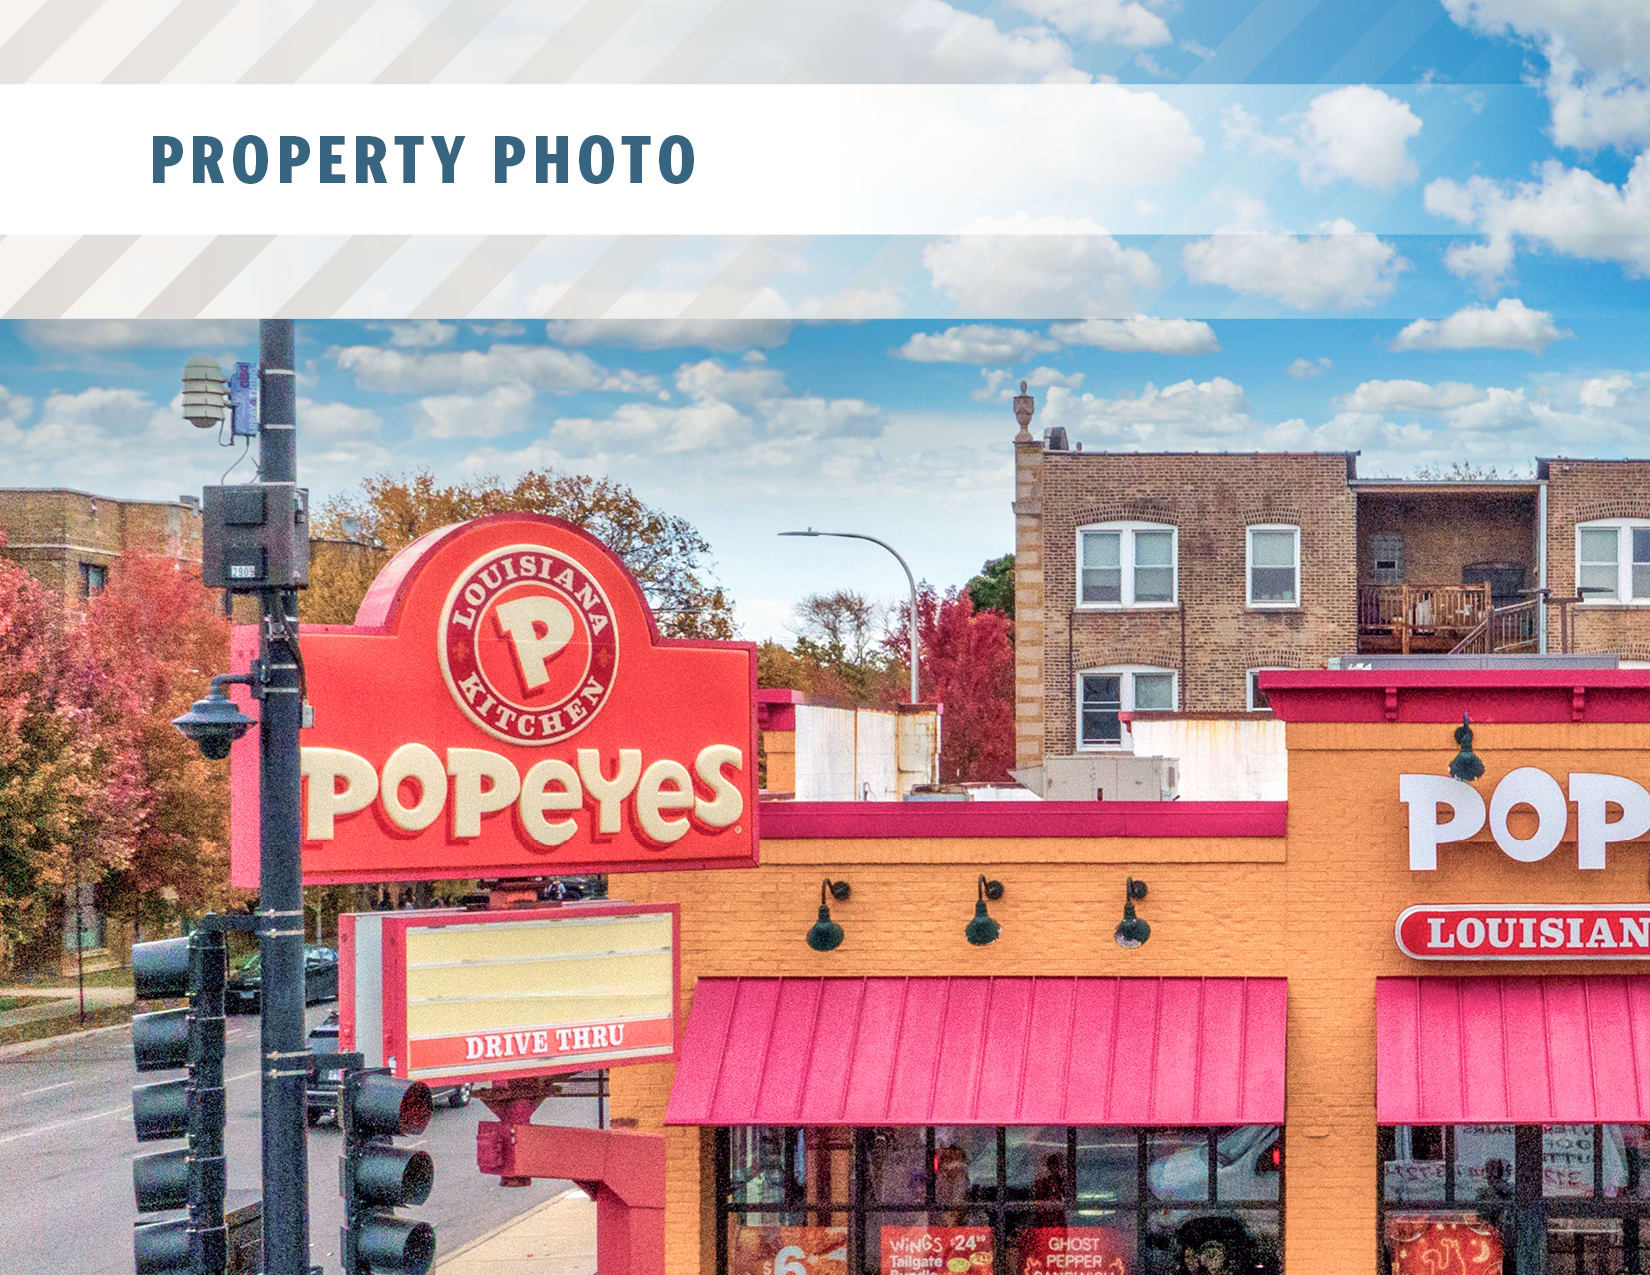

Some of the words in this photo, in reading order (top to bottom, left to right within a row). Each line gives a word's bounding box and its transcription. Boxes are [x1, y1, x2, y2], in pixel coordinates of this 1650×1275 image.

[453, 555, 608, 636] LOUISIANA
[458, 672, 604, 736] KITCHEN
[465, 1031, 549, 1060] DRIVE
[556, 1024, 625, 1051] THRU
[1048, 1237, 1100, 1251] GHOST
[890, 1255, 943, 1270] Tailgate
[1047, 1254, 1103, 1268] PEPPER
